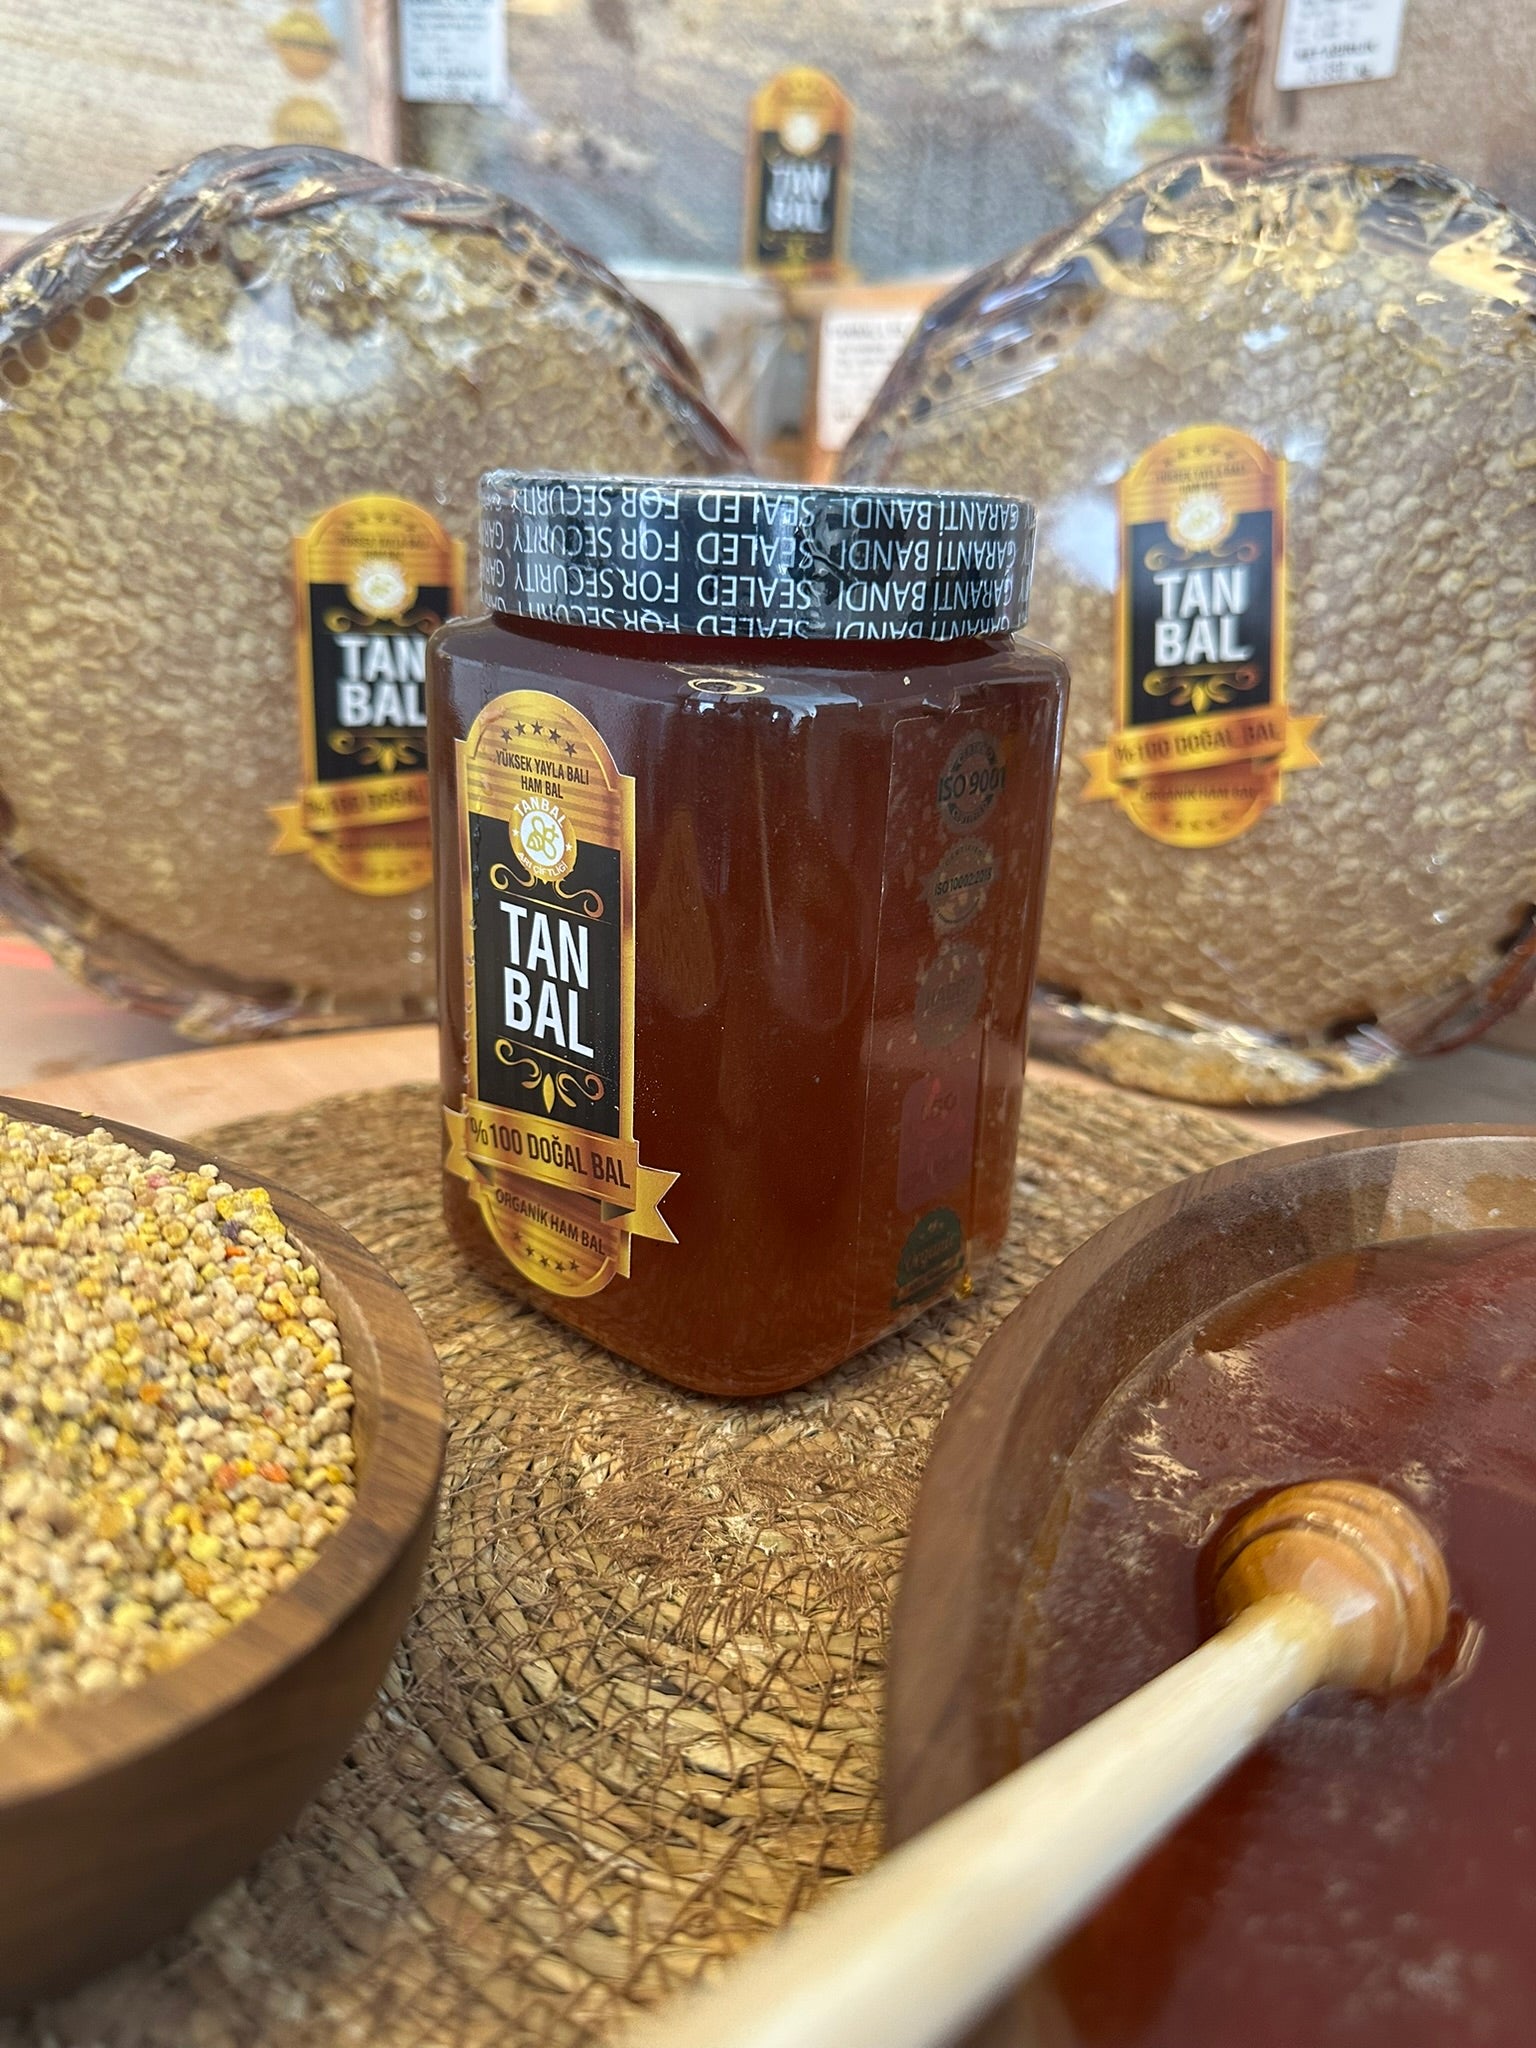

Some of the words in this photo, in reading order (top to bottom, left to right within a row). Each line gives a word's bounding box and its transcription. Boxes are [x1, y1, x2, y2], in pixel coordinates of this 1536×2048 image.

[510, 484, 613, 518] SECURITY
[620, 487, 680, 520] FOR
[698, 492, 816, 527] SEALED
[841, 498, 932, 530] BANDI
[939, 500, 1019, 536] GARANTİ
[512, 523, 613, 558] SECURITY
[620, 527, 680, 561] FOR
[697, 532, 813, 569] SEALED
[840, 539, 929, 571] BANDI
[935, 540, 1017, 576] GARANTİ
[514, 562, 614, 598] SECURITY
[620, 569, 680, 603] FOR
[697, 574, 812, 609] SEALED
[838, 580, 927, 612] BANDI
[933, 579, 1013, 617] GARANTİ
[1153, 566, 1250, 620] TAN
[333, 634, 426, 682] TAN
[1155, 615, 1253, 667] BAL
[337, 680, 427, 727] BAL
[495, 749, 533, 773] YÜKSEK
[534, 758, 565, 780] YAYLA
[566, 767, 590, 785] BALI
[938, 773, 967, 802] ISO
[968, 766, 1007, 796] 9001
[520, 775, 543, 795] HAM
[544, 781, 564, 799] BAL
[513, 796, 567, 829] TANBAL
[500, 900, 590, 989] TAN
[504, 965, 595, 1059] BAL
[470, 1116, 523, 1156] %100
[527, 1132, 588, 1176] DOĞAL
[591, 1152, 631, 1190] BAL
[495, 1187, 549, 1228] ORGANİK
[549, 1213, 579, 1243] HAM
[581, 1230, 606, 1256] BAL
